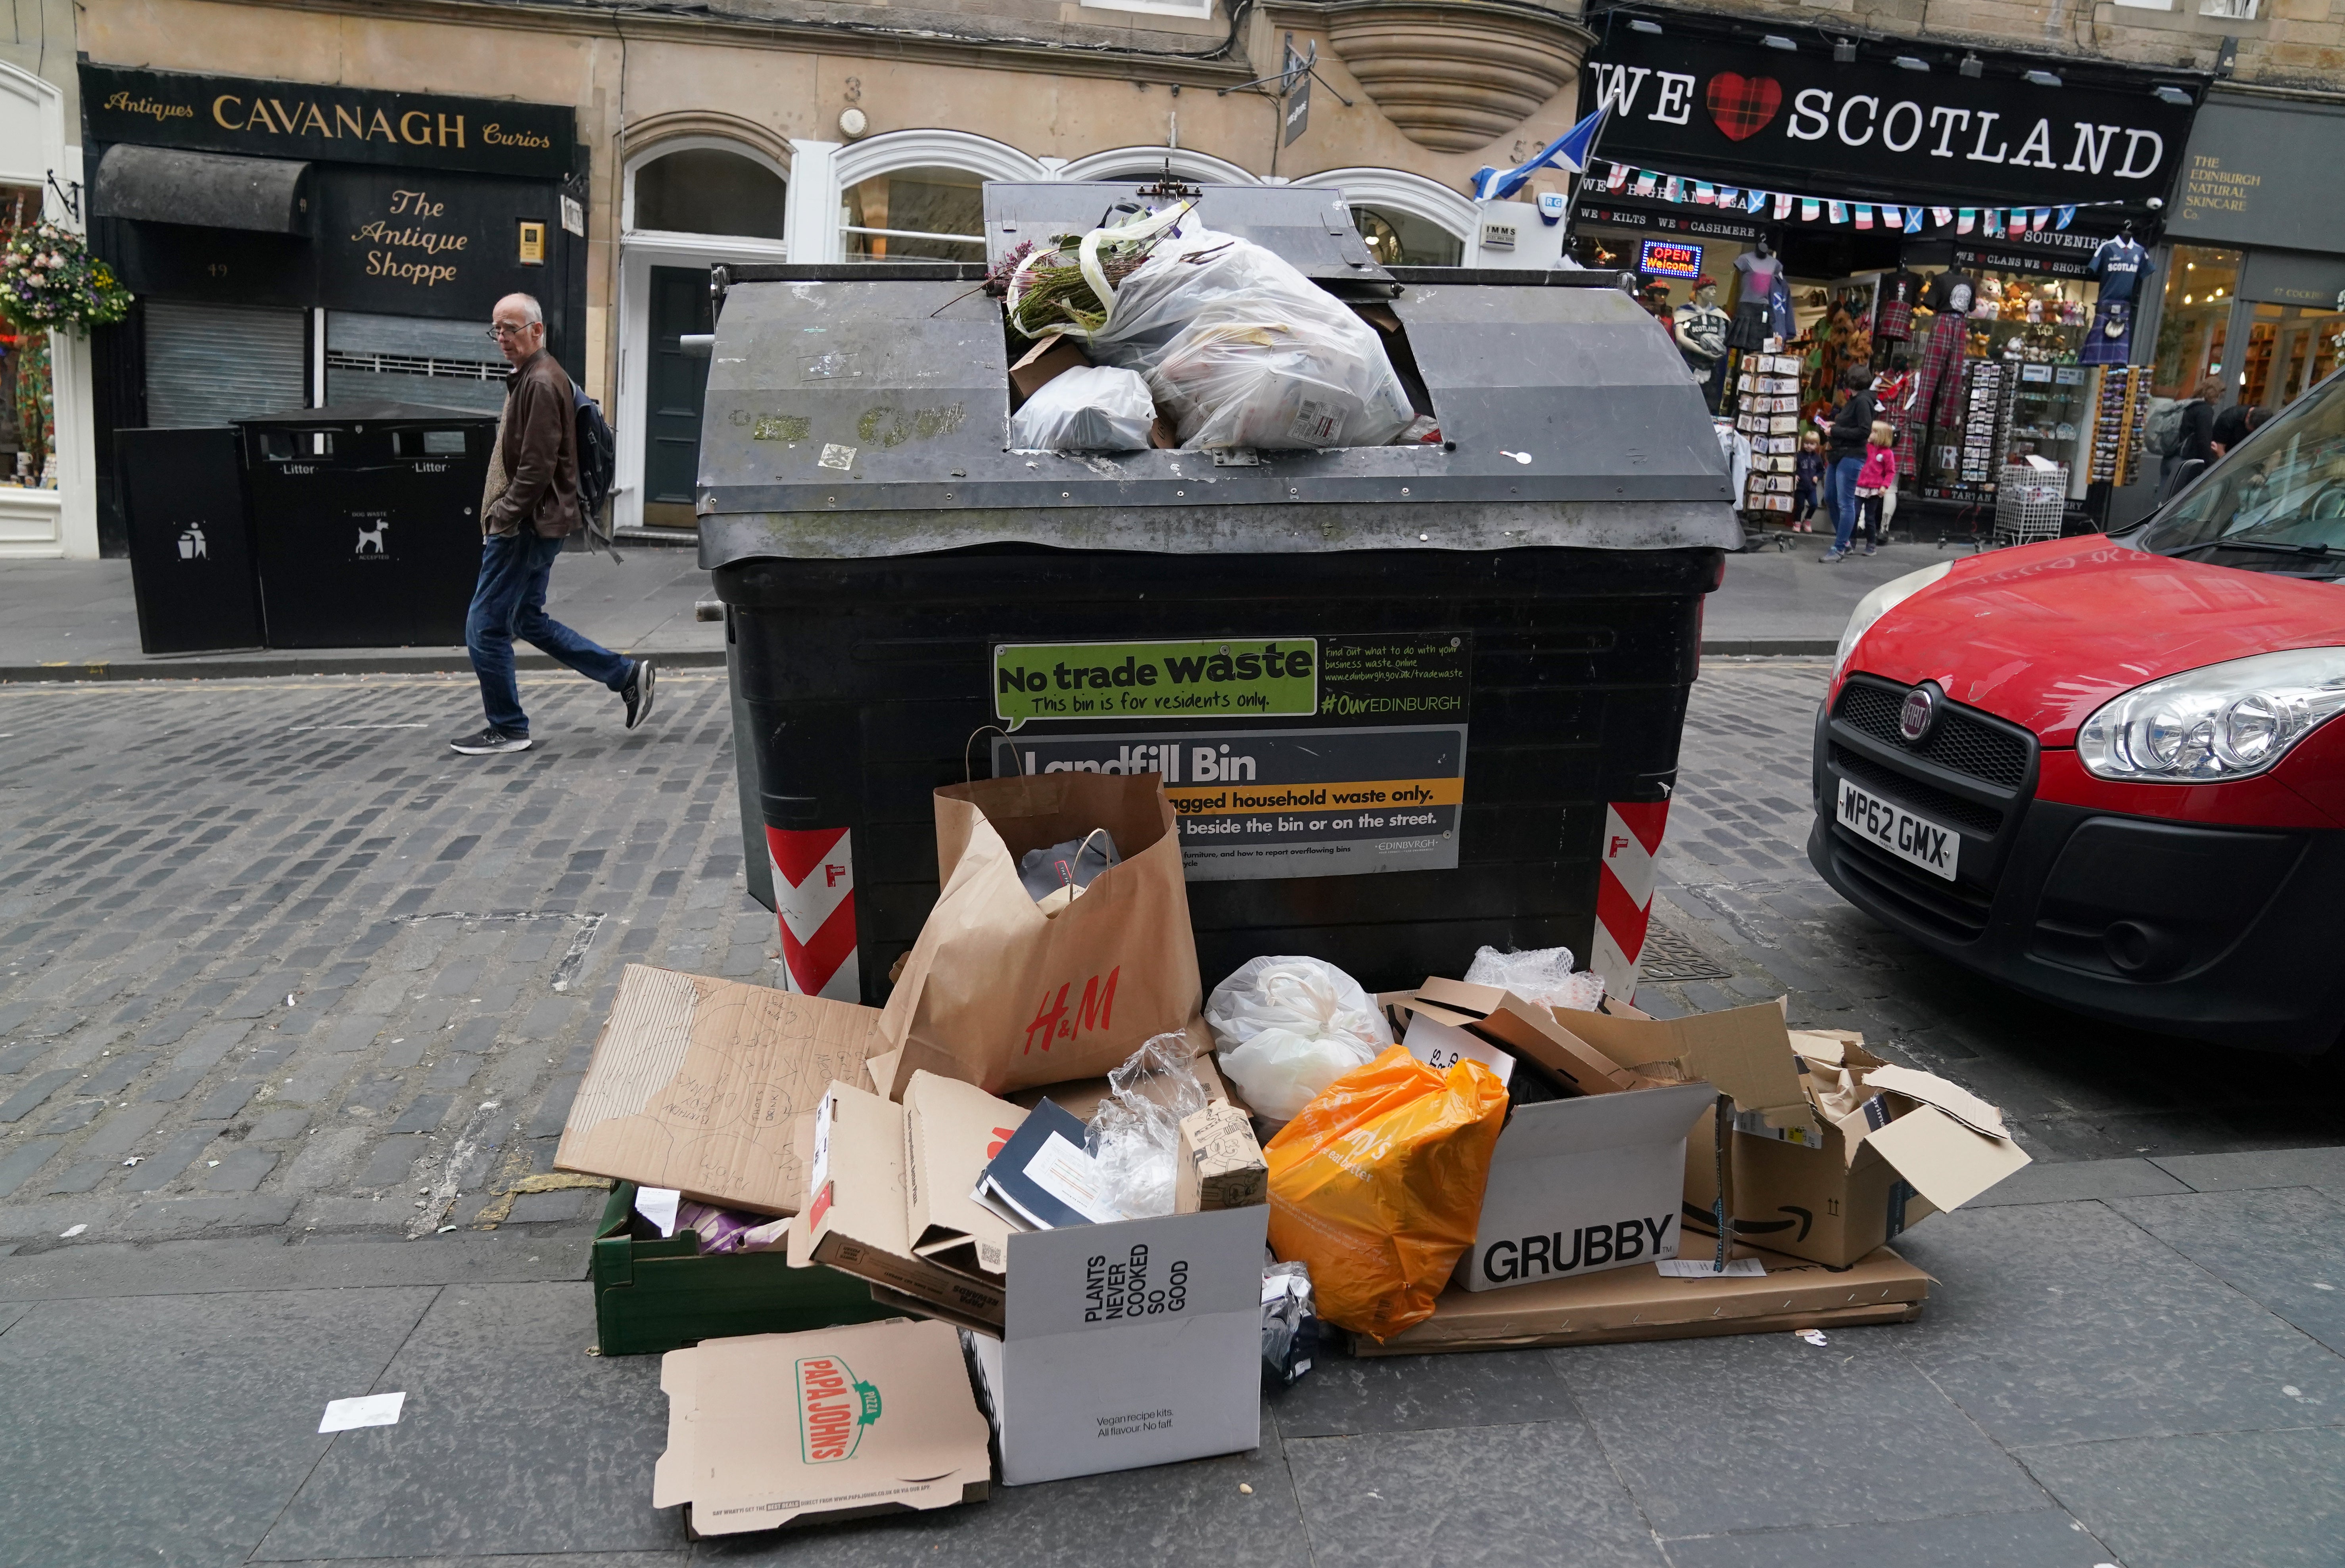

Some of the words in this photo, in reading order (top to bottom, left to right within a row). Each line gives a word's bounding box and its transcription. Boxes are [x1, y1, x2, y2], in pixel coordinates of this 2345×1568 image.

[104, 91, 193, 122] Antiques
[212, 94, 465, 148] CAVANAGH
[483, 123, 550, 149] Curios
[1589, 61, 1694, 125] WE
[1787, 88, 2163, 179] SCOTLAND
[2194, 155, 2219, 169] THE
[1583, 178, 1606, 192] WE
[2190, 169, 2261, 187] EDINBURGH
[2188, 182, 2247, 198] NATURAL
[390, 190, 444, 217] The
[1546, 197, 1561, 207] RG
[2186, 195, 2247, 211] SKINCARE
[1581, 207, 1598, 219] WE
[1612, 213, 1646, 224] KILTS
[351, 220, 468, 255] Antique
[1658, 218, 1676, 228] WE
[1691, 222, 1755, 237] CASHMERE
[1645, 257, 1694, 273] Welcome
[1654, 246, 1691, 262] OPEN
[1957, 252, 1974, 262] WE
[1987, 256, 2021, 268] CLANS
[2024, 259, 2040, 269] WE
[208, 263, 227, 277] 49
[366, 250, 457, 287] Shoppe
[283, 463, 315, 475] Litter
[415, 461, 447, 473] Litter
[1925, 488, 1939, 498] WE
[1952, 491, 1992, 502] TARTAN
[1326, 647, 1343, 657] Find
[1347, 648, 1361, 656] out
[1365, 646, 1386, 656] what
[1391, 646, 1400, 654] to
[1418, 645, 1435, 654] with
[1439, 646, 1457, 657] your
[999, 667, 1047, 693] No
[1053, 656, 1158, 690] trade
[1164, 642, 1313, 684] waste
[1325, 660, 1361, 670] business
[1366, 658, 1391, 668] waste
[1395, 658, 1417, 667] online
[1325, 669, 1463, 682] www.edinburgh.gov.uk/tradewaste
[1031, 694, 1066, 713] This
[1073, 693, 1094, 712] bin
[1101, 693, 1113, 710] is
[1121, 691, 1148, 709] for
[1154, 691, 1230, 709] residents
[1237, 691, 1270, 711] only.
[1906, 703, 1926, 725] FIAT
[1192, 744, 1256, 782] Bin
[1169, 793, 1226, 813] agged
[1233, 789, 1326, 807] household
[1332, 790, 1386, 803] waste
[1392, 785, 1433, 804] only.
[1187, 819, 1241, 834] beside
[1246, 818, 1272, 832] the
[1278, 817, 1303, 832] bin
[1309, 820, 1327, 830] or
[1332, 819, 1353, 829] on
[1359, 813, 1384, 828] the
[1389, 813, 1436, 826] street.
[1845, 787, 1893, 843] WP62
[1898, 816, 1947, 868] GMX
[1024, 965, 1120, 1055] H&M
[1871, 1097, 1885, 1127] prime
[1328, 1150, 1343, 1164] eat
[1340, 1158, 1374, 1183] better
[1483, 1213, 1673, 1283] GRUBBY
[1085, 1255, 1105, 1322] PLANTS
[1106, 1263, 1126, 1320] NEVER
[1126, 1244, 1148, 1317] COOKED
[1168, 1260, 1188, 1311] GOOD
[1147, 1290, 1165, 1314] SO
[804, 1360, 847, 1401] PAPA
[864, 1391, 877, 1413] PIZZA
[1097, 1416, 1126, 1426] Vegan
[1128, 1412, 1155, 1421] recipe
[1157, 1409, 1173, 1417] kits.
[1098, 1428, 1109, 1438] All
[1111, 1425, 1142, 1436] flavour.
[1144, 1422, 1156, 1430] No
[1159, 1419, 1173, 1428] faff.
[808, 1402, 851, 1459] JOHN'S
